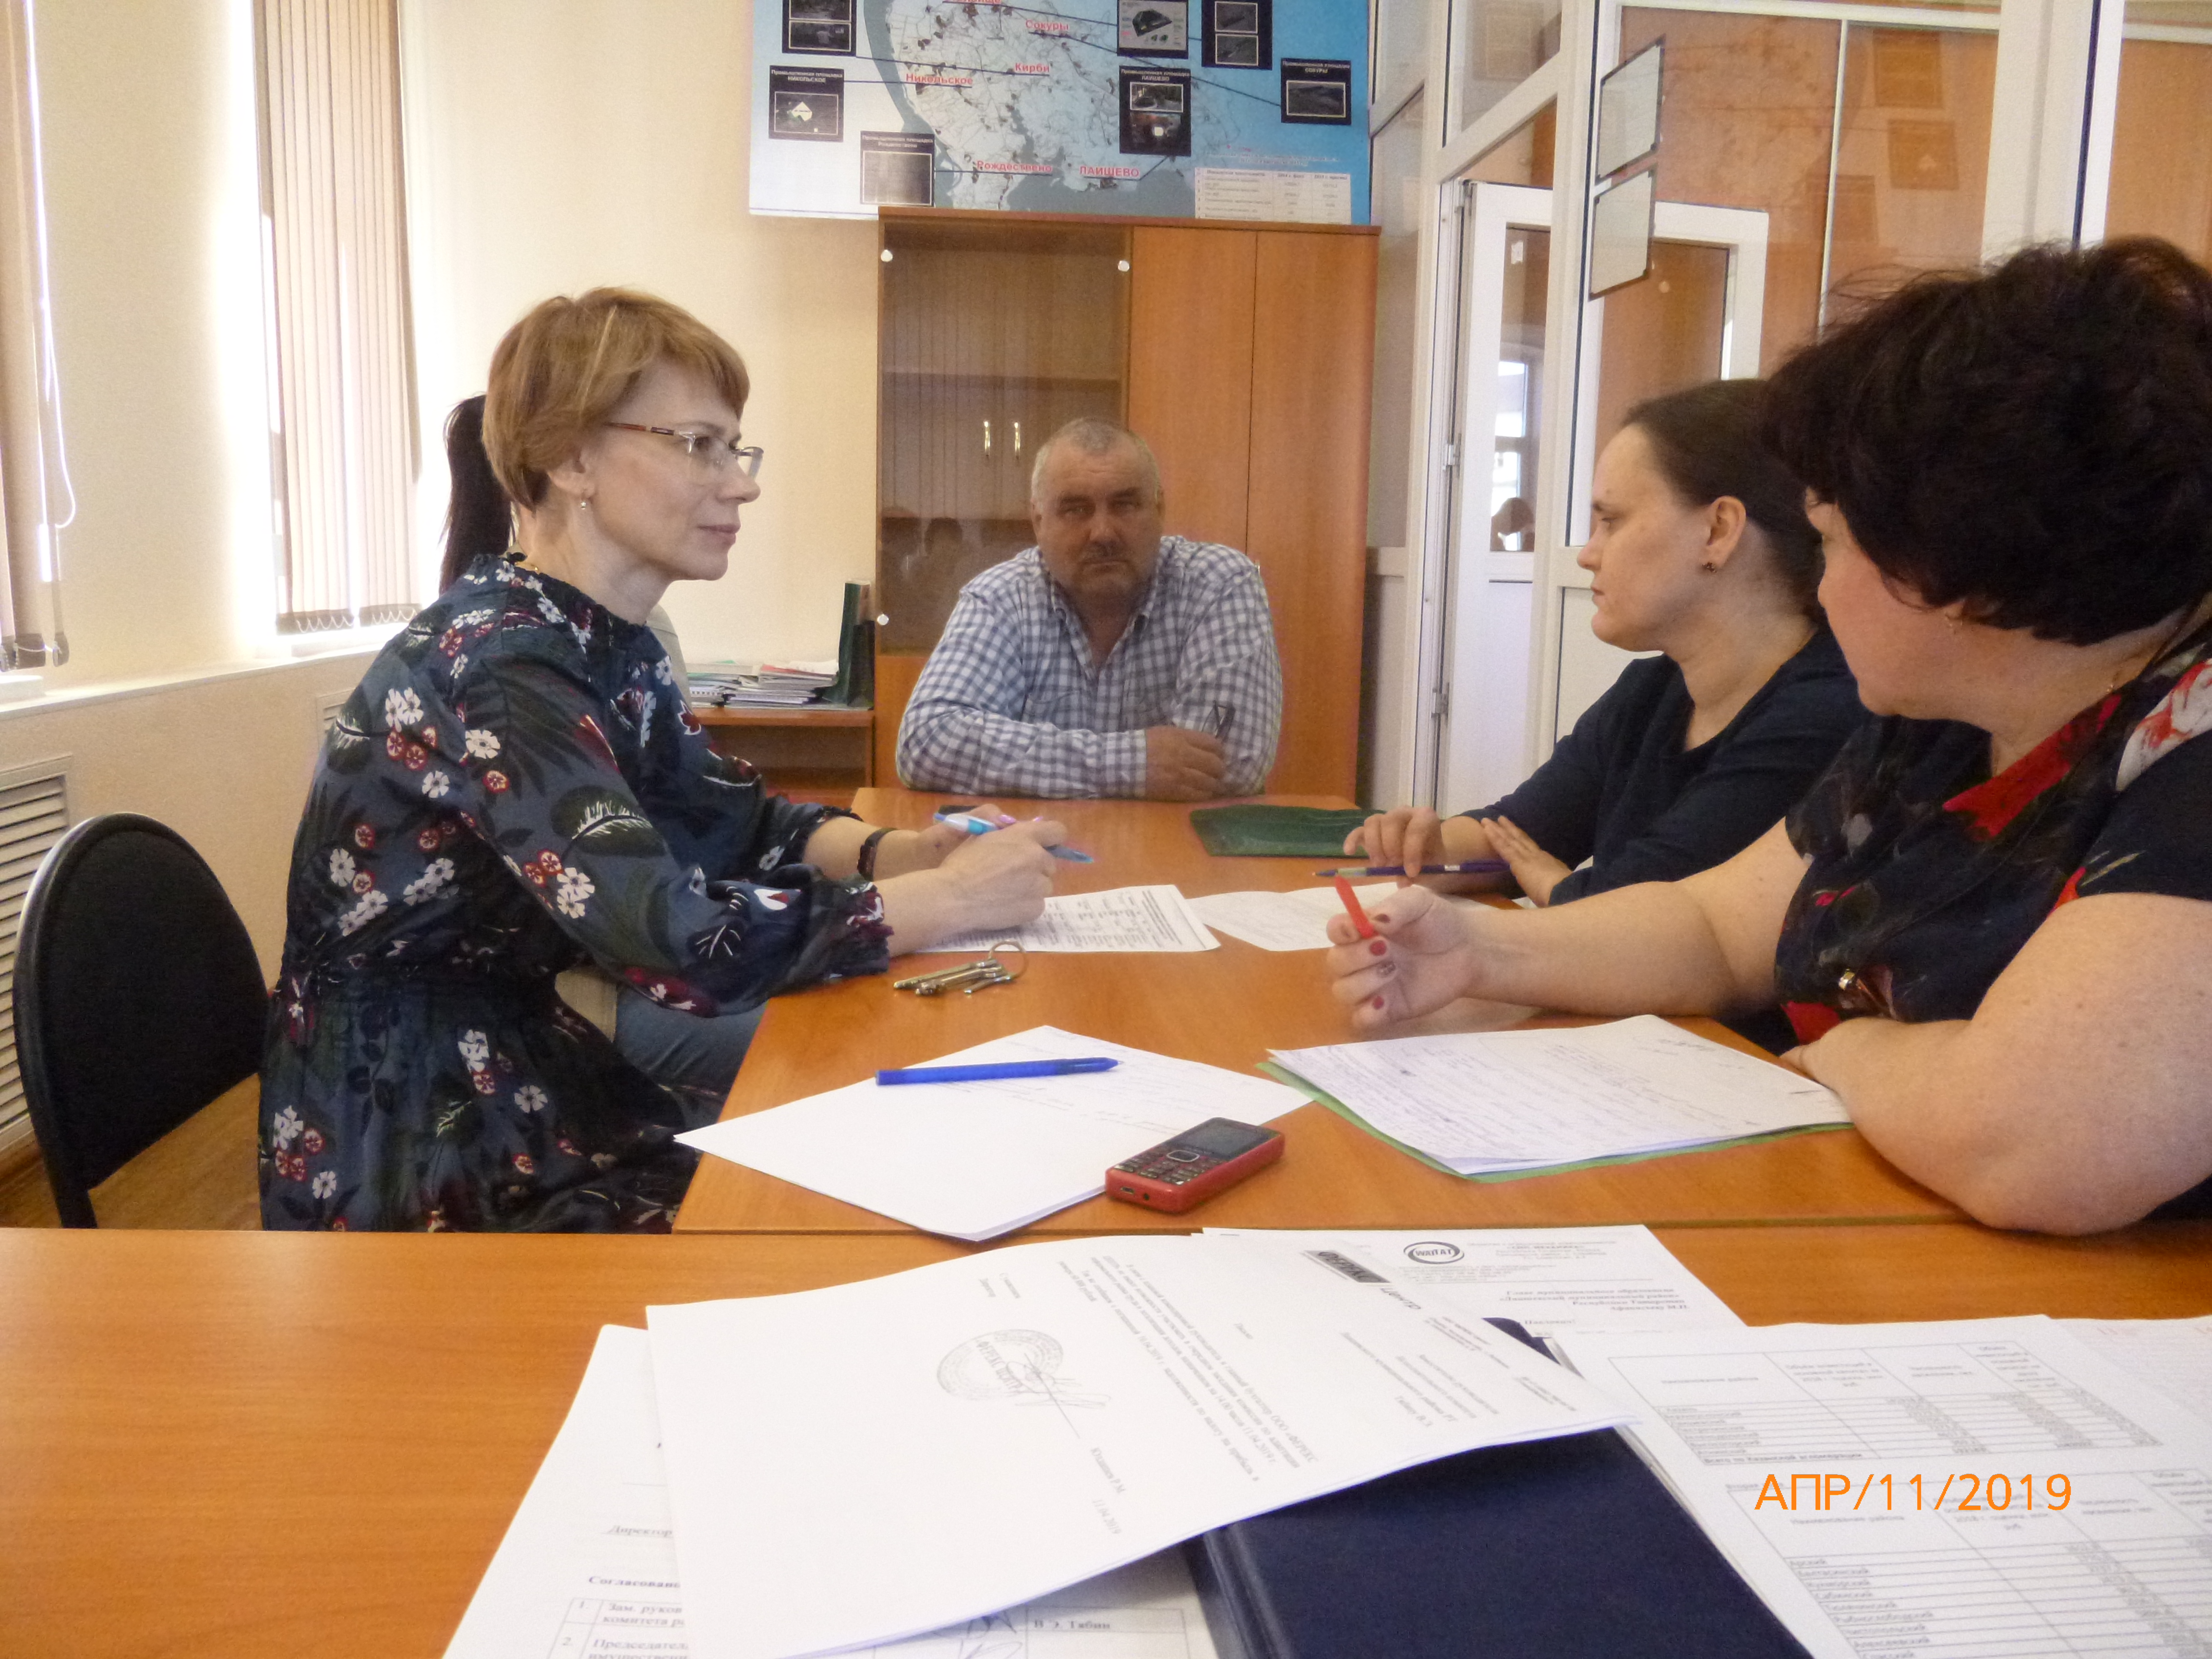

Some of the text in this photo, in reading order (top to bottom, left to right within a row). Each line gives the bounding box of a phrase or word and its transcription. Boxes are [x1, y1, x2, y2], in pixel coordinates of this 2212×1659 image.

[1025, 20, 1069, 31] Сокуры
[1015, 62, 1050, 72] Кирби
[906, 73, 974, 85] Никольское
[976, 160, 1053, 173] Рождествено
[603, 1615, 669, 1625] комитета
